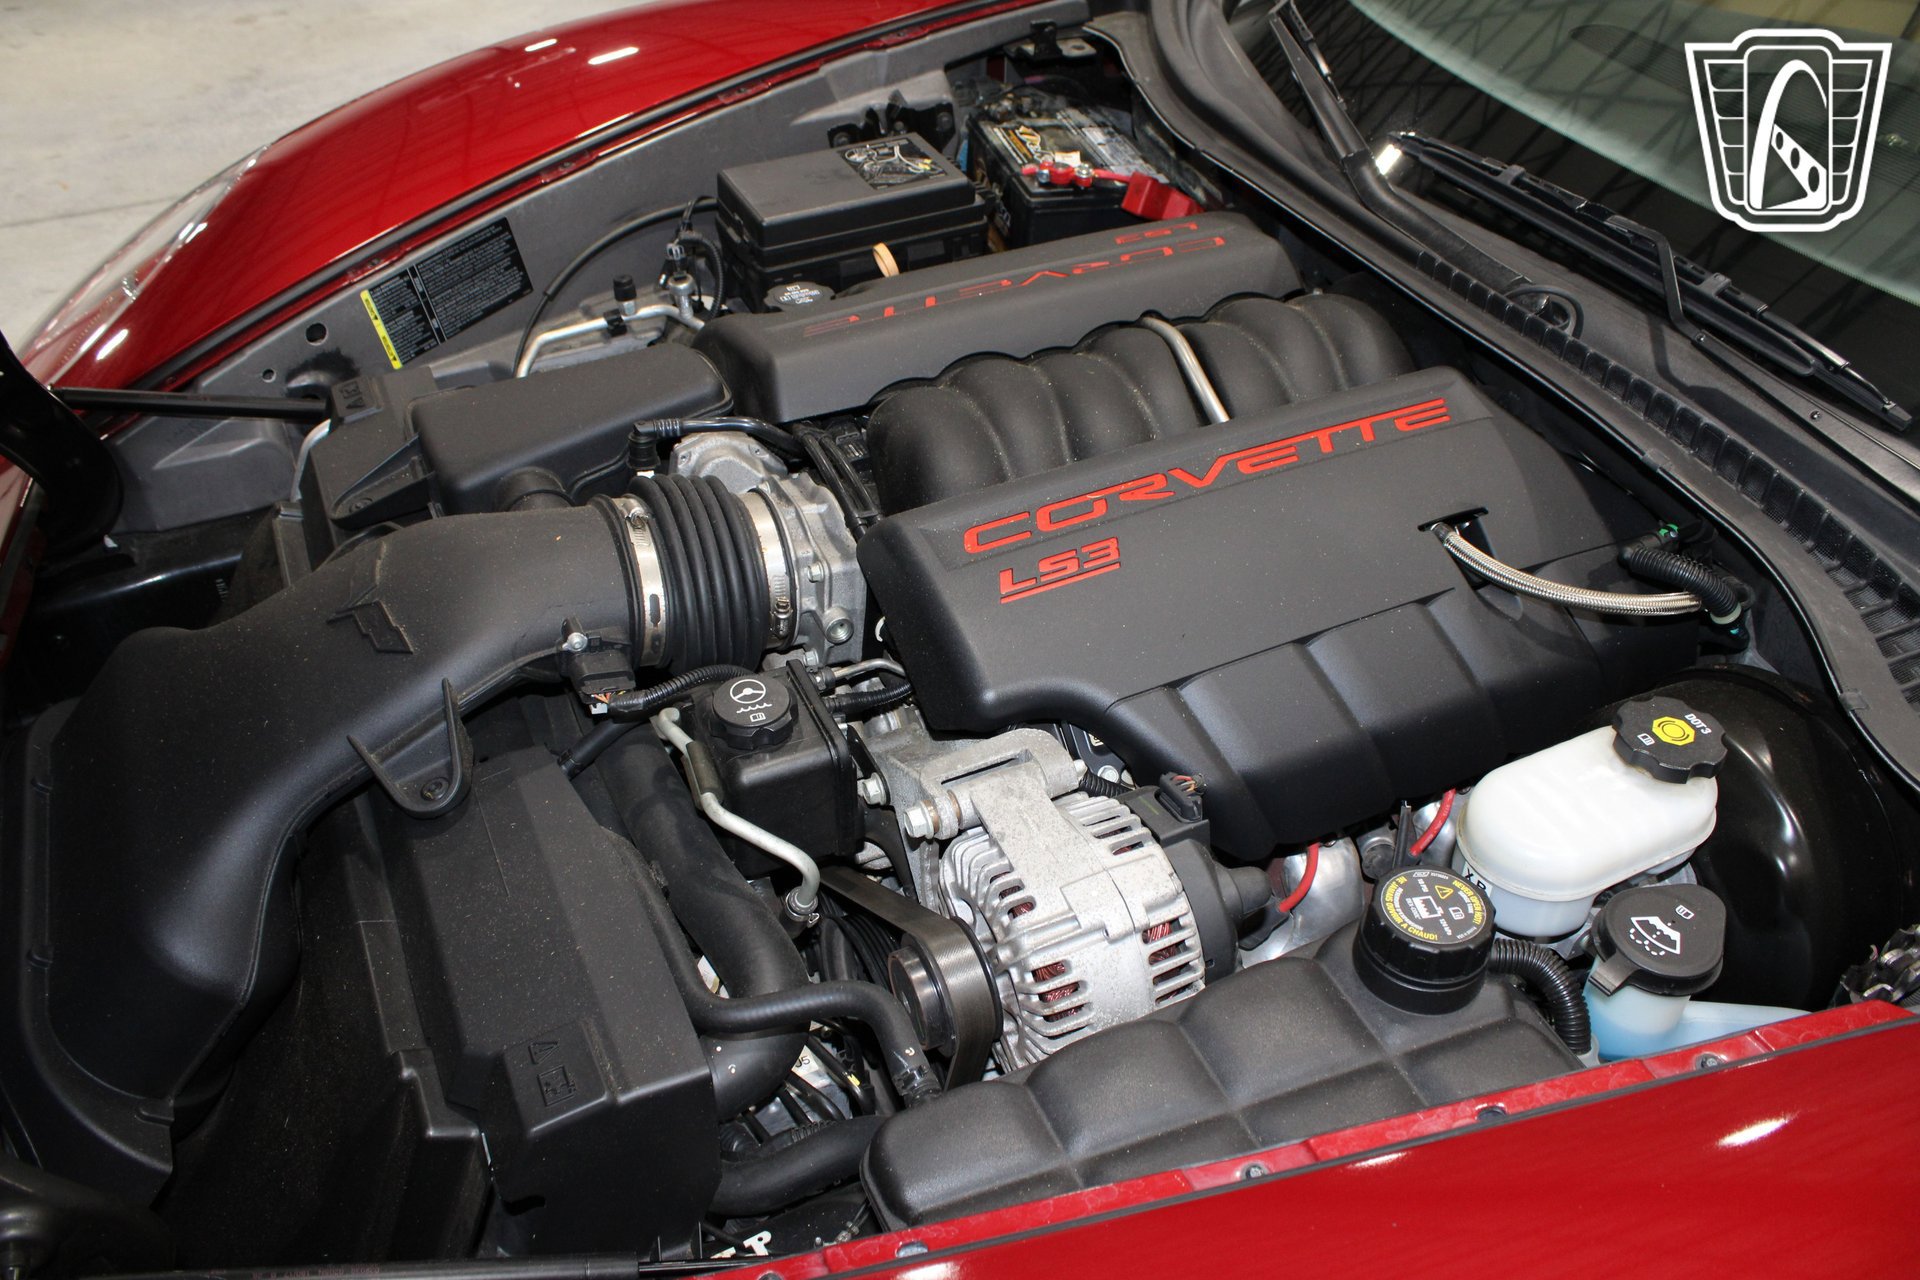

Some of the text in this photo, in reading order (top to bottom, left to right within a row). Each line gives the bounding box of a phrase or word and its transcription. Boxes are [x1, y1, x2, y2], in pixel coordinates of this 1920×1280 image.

[964, 398, 1452, 554] CORVETTE
[999, 537, 1120, 596] LS3
[1452, 880, 1483, 925] NEVER OPEN HOT!
[1407, 925, 1438, 941] CHAUD!
